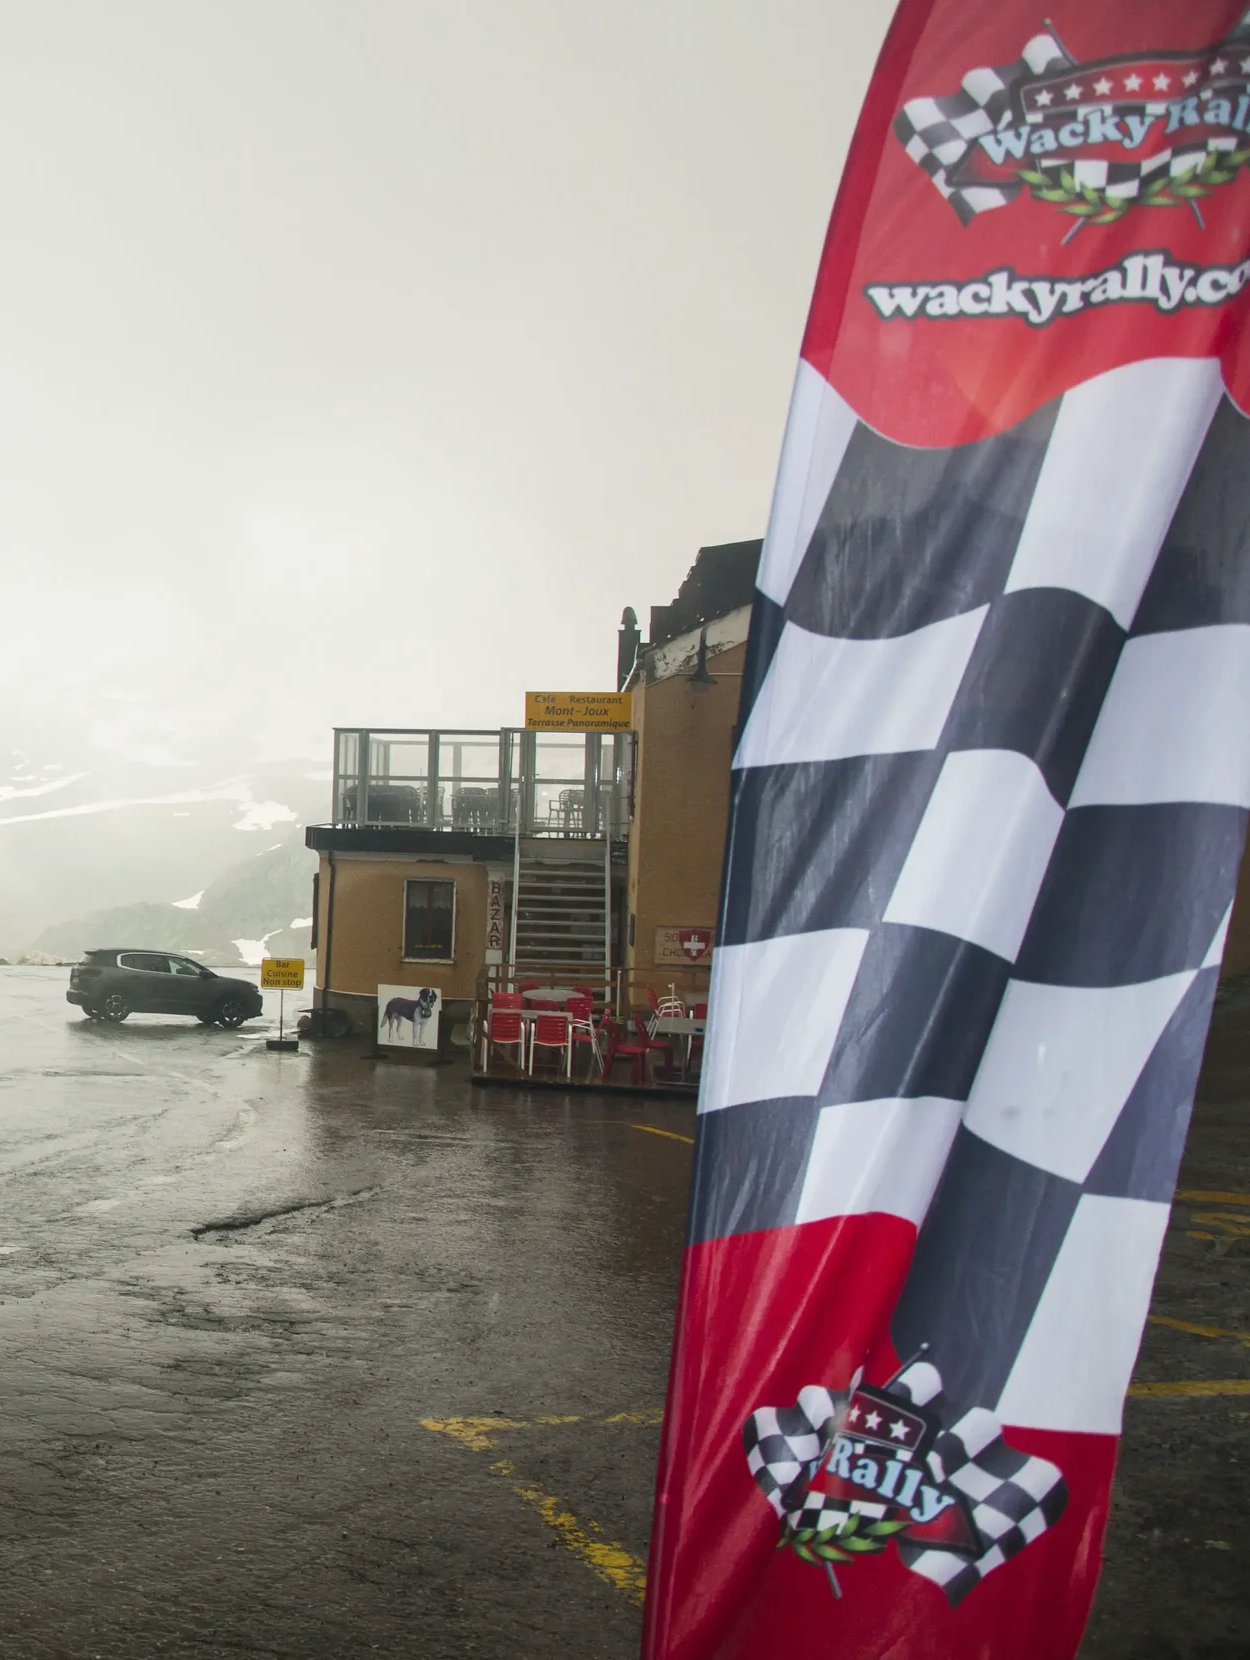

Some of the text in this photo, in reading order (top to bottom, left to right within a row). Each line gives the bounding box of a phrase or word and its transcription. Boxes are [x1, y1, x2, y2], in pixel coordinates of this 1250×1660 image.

[978, 93, 1250, 165] Wacky Ral
[569, 695, 623, 704] Restaurant
[544, 705, 575, 716] Mont
[583, 706, 610, 716] Joux
[527, 718, 630, 729] Terrasse Panoramique
[489, 882, 501, 947] BAZAR
[275, 960, 290, 968] Bar
[267, 969, 298, 978] Cuisine
[263, 977, 302, 987] Non stop
[826, 1436, 956, 1523] Rally
